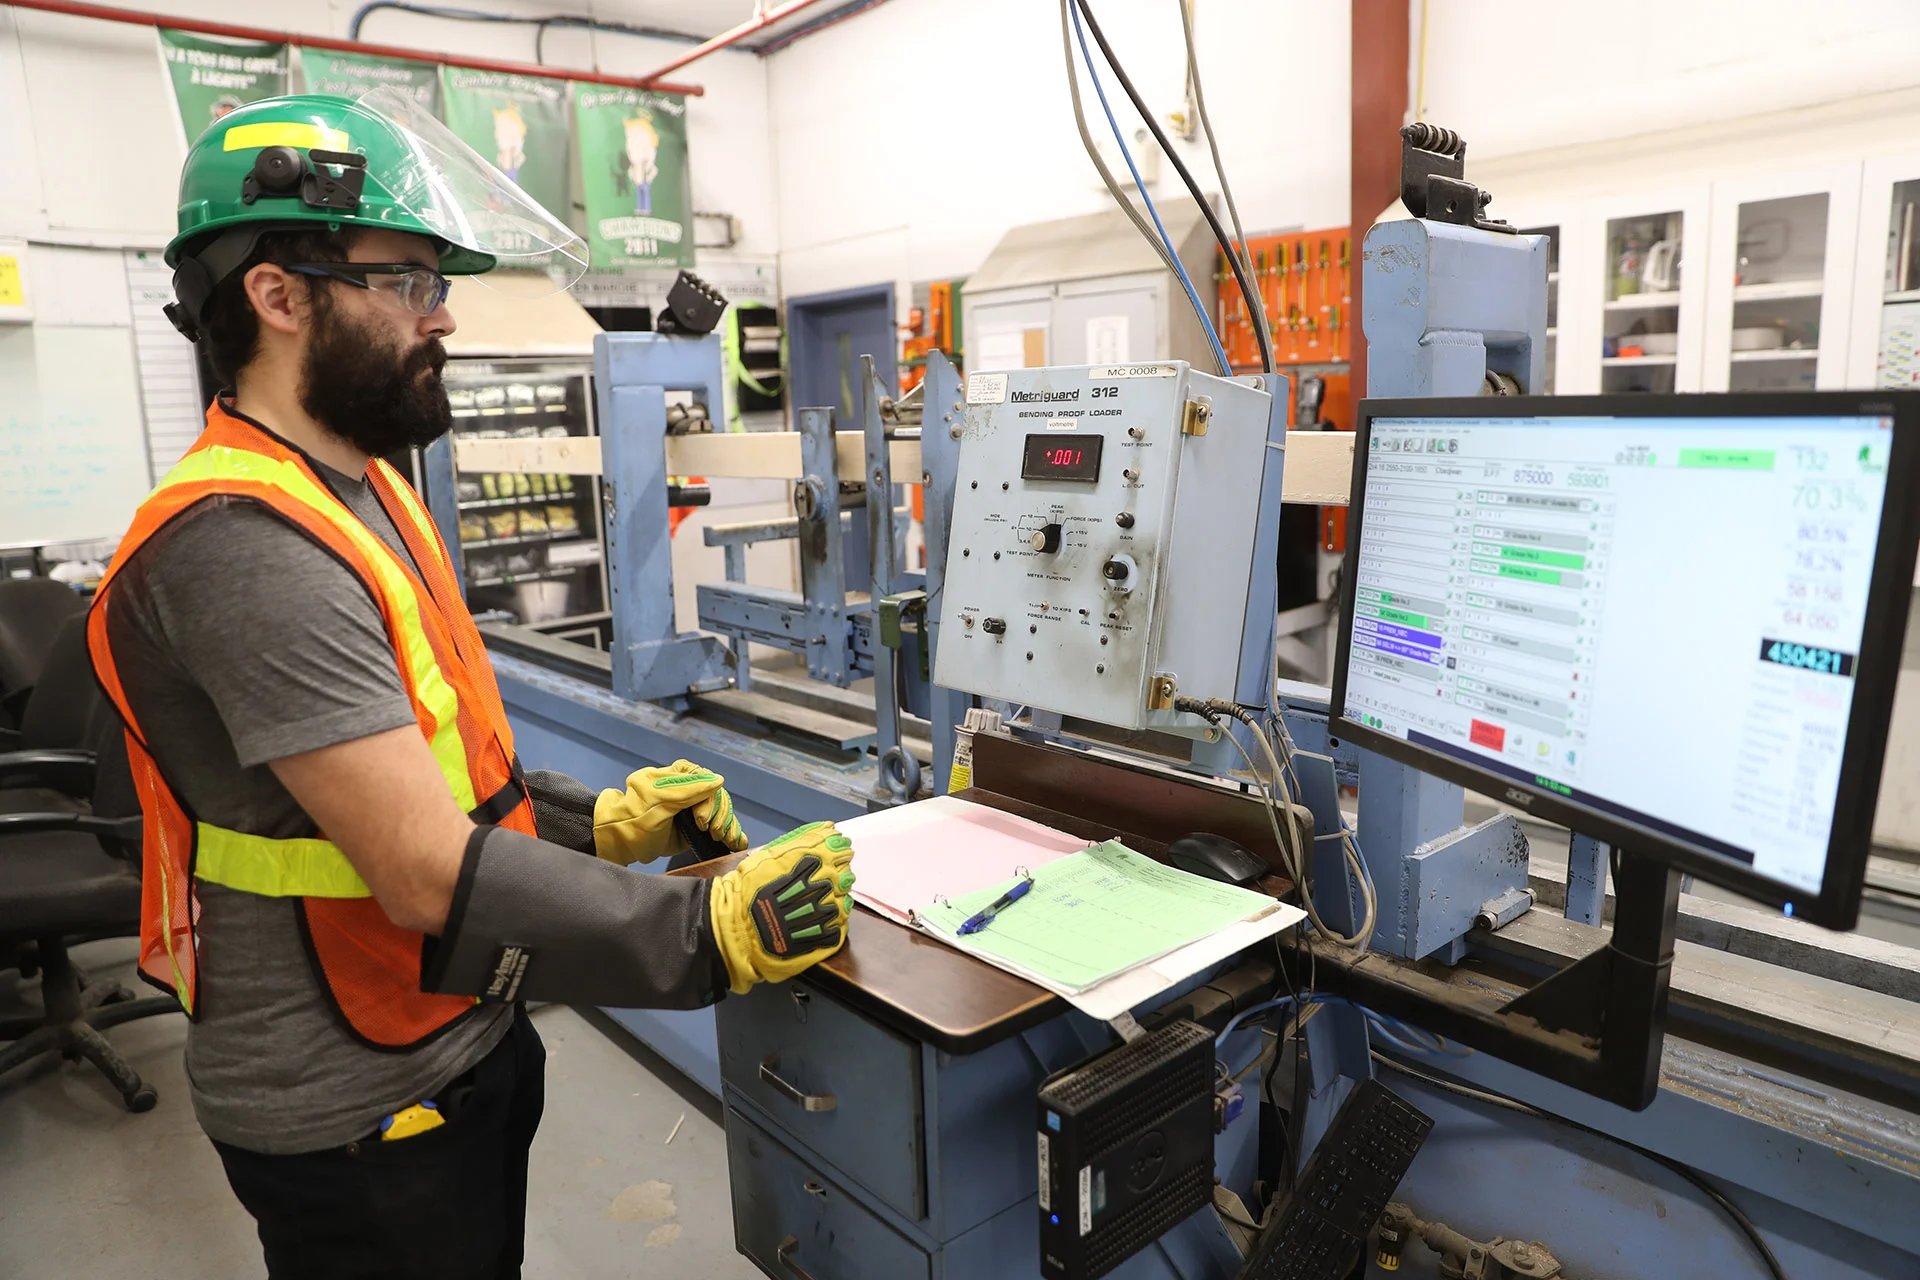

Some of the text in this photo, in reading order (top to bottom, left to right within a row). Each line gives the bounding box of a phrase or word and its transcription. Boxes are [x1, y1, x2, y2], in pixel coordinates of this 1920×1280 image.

[624, 237, 659, 256] 2011
[1107, 367, 1158, 377] MC 0008
[1011, 388, 1080, 403] Metriguard
[1091, 387, 1119, 398] 312
[1089, 409, 1122, 417] LOADER
[1513, 470, 1553, 485] 875000
[1767, 641, 1843, 675] 450421
[1505, 788, 1535, 805] acer
